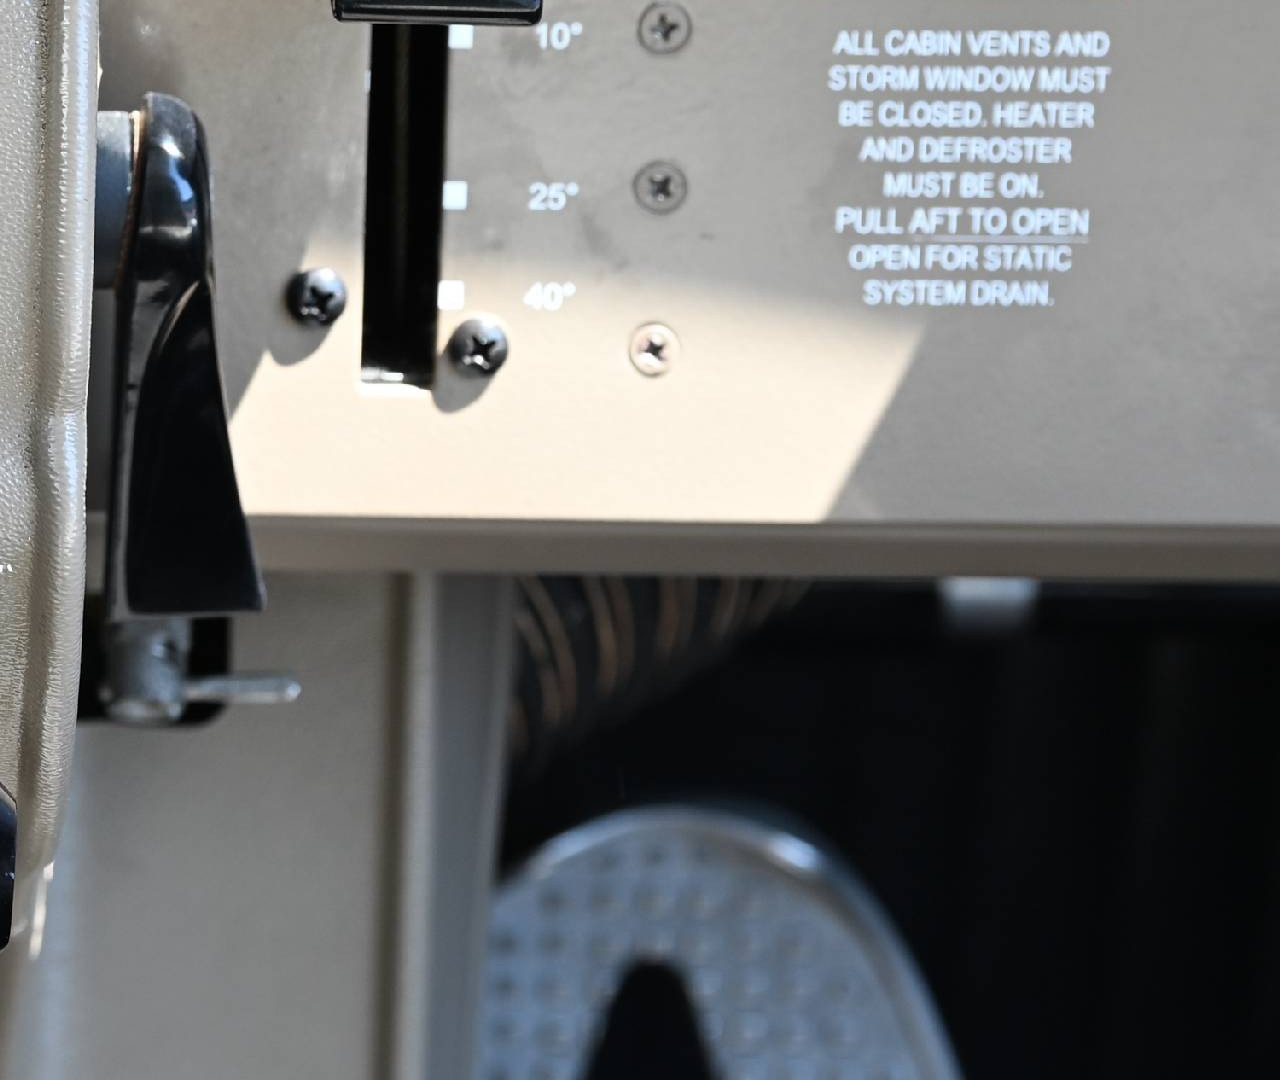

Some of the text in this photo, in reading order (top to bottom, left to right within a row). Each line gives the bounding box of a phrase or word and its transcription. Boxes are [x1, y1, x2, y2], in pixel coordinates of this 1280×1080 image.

[535, 22, 583, 50] 10°
[833, 30, 1110, 57] ALL CABIN VENTS AND
[828, 66, 1111, 91] STORM WINDOW MUST
[838, 101, 1094, 128] BE CLOSED. HEATER
[860, 137, 1072, 163] AND DEFROSTER
[528, 182, 578, 210] 25°
[883, 172, 1044, 198] MUST BE ON.
[835, 207, 1089, 235] PULL AFT TO OPEN
[849, 245, 1072, 271] OPEN FOR STATIC
[523, 282, 576, 310] 40°
[863, 280, 1054, 306] SYSTEM DRAIN.
